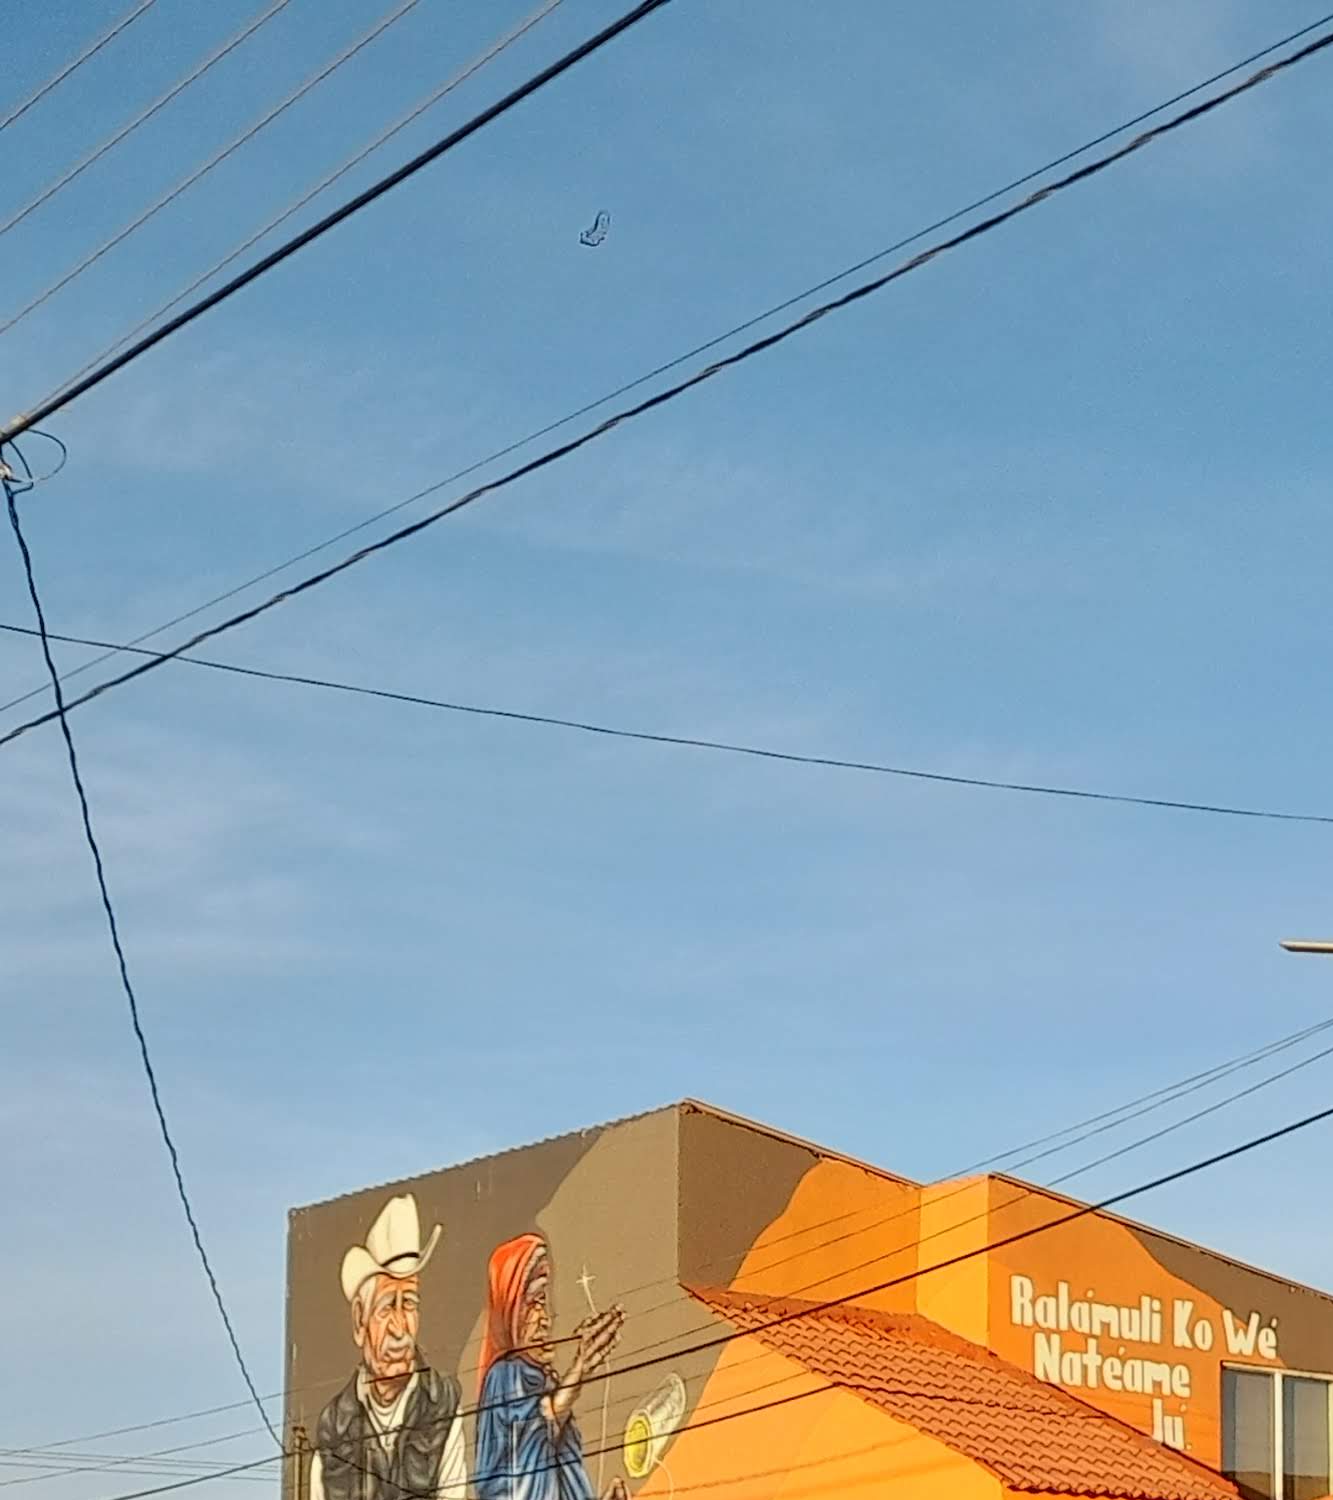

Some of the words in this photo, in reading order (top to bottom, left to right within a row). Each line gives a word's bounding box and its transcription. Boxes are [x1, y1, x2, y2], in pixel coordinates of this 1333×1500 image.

[1010, 1274, 1162, 1344] Ralámuli
[1172, 1299, 1214, 1351] Ko
[1222, 1309, 1278, 1360] Wé
[1034, 1331, 1191, 1398] Natéame
